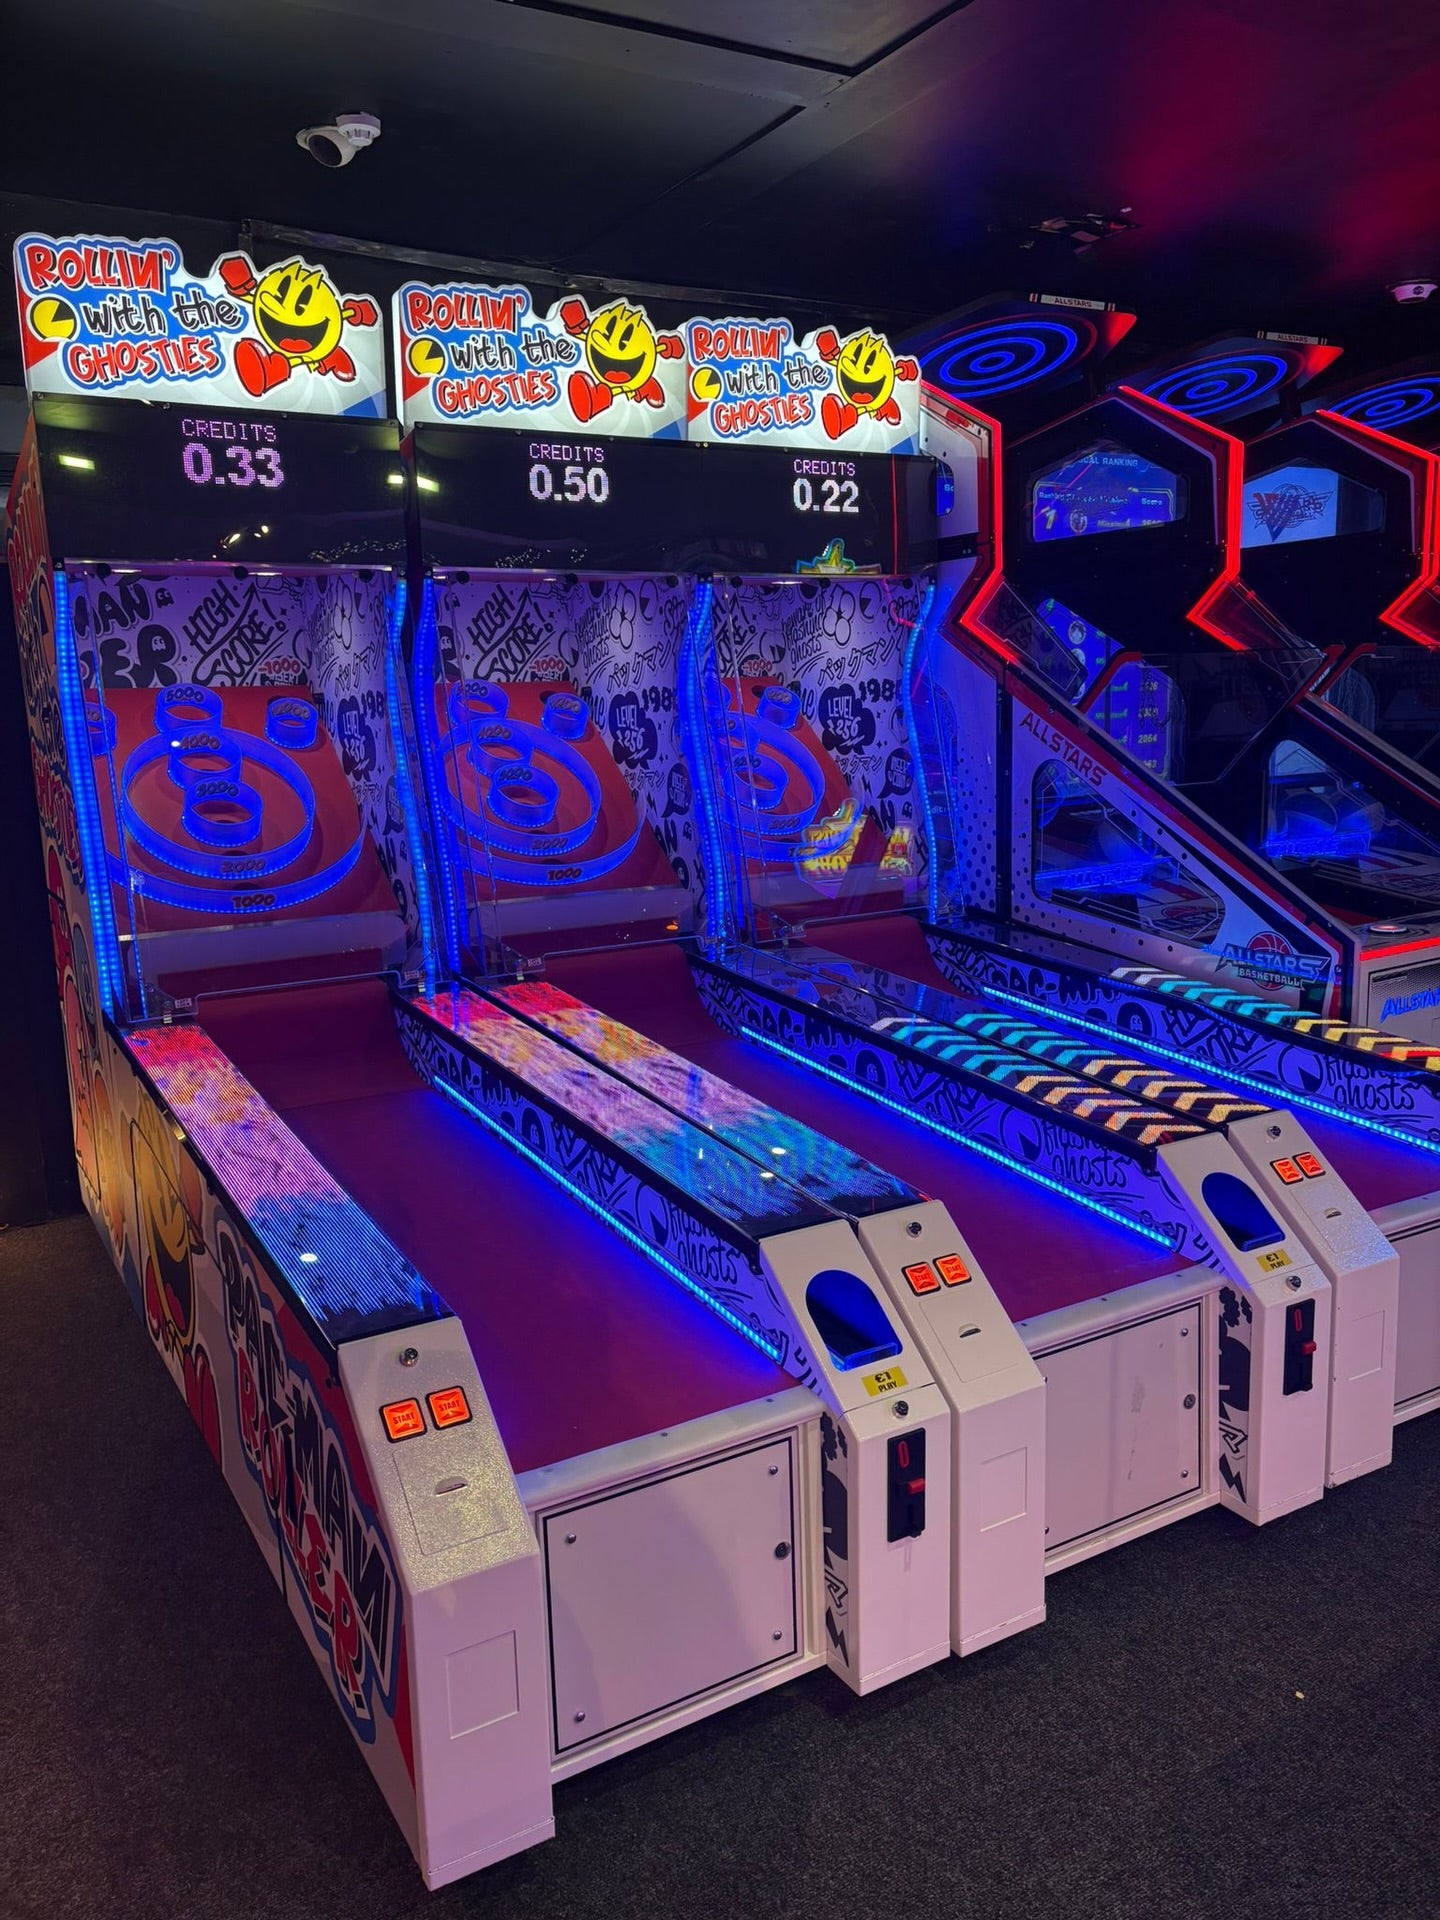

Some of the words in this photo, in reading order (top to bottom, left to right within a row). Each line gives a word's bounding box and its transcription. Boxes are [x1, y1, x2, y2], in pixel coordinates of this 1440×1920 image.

[25, 245, 174, 293] ROLLIN'
[83, 296, 166, 335] with
[172, 288, 243, 329] the
[408, 291, 526, 332] ROLLIN'
[1054, 297, 1093, 308] ALLSTARS
[451, 335, 516, 371] with
[521, 330, 577, 363] the
[693, 327, 790, 362] ROLLIN'
[67, 337, 219, 383] GHOSTIES
[725, 364, 779, 395] with
[783, 358, 831, 388] the
[438, 370, 557, 412] GHOSTIES
[714, 397, 812, 431] GHOSTIES
[182, 419, 277, 442] CREDITS
[183, 443, 284, 488] 0.33
[529, 443, 605, 463] CREDITS
[1103, 458, 1138, 467] RANKING
[793, 459, 856, 476] CREDITS
[529, 464, 609, 503] 0.50
[793, 479, 860, 514] 0.22
[183, 579, 241, 647] HIGH
[467, 584, 515, 646] HIGH
[258, 657, 302, 674] -1000
[529, 657, 566, 673] -1000
[166, 686, 204, 703] 5000
[642, 685, 676, 712] 198
[858, 678, 904, 702] 198
[616, 704, 639, 731] LEVEL
[827, 695, 853, 720] LEVEL
[181, 733, 220, 750] 4000
[624, 727, 646, 752] 256
[836, 717, 862, 740] 256
[1020, 711, 1108, 787] ALLSTARS
[548, 867, 583, 880] 1000
[232, 893, 276, 909] 1000
[1224, 945, 1322, 977] ALLSTARS
[1238, 967, 1300, 986] BASKETBALL
[878, 1381, 898, 1393] PLAY
[392, 1412, 415, 1425] START
[439, 1400, 460, 1412] START
